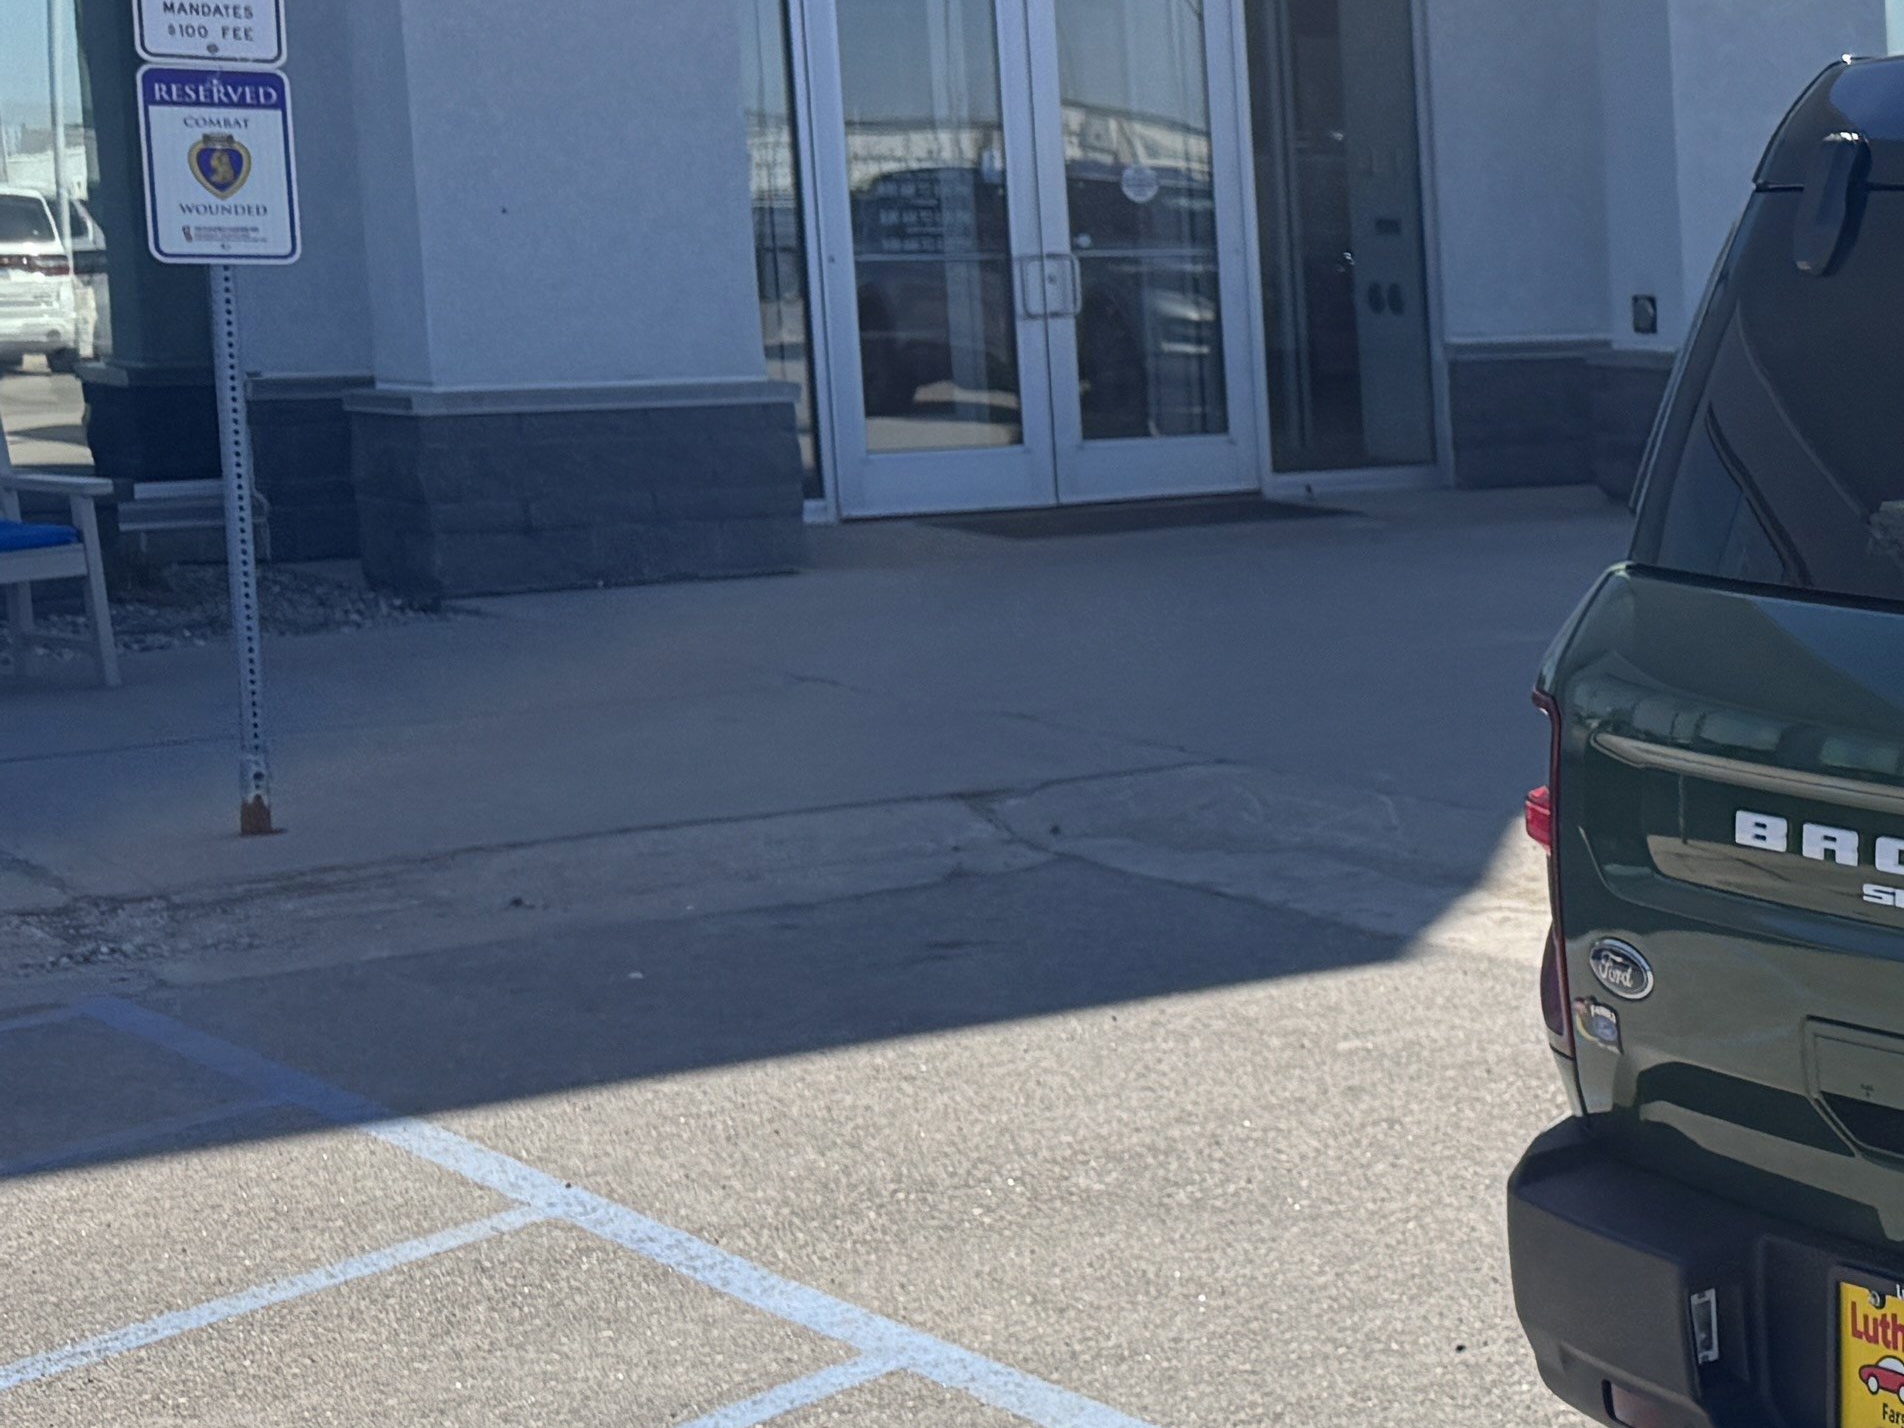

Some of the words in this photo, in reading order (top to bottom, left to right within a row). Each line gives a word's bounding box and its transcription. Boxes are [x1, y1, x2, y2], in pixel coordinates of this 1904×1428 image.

[162, 0, 254, 20] MANDATES
[167, 23, 209, 40] $100
[221, 25, 254, 42] FEE
[153, 81, 278, 105] RESERVED
[183, 115, 250, 129] COMBAT
[178, 202, 268, 217] WOUNDED
